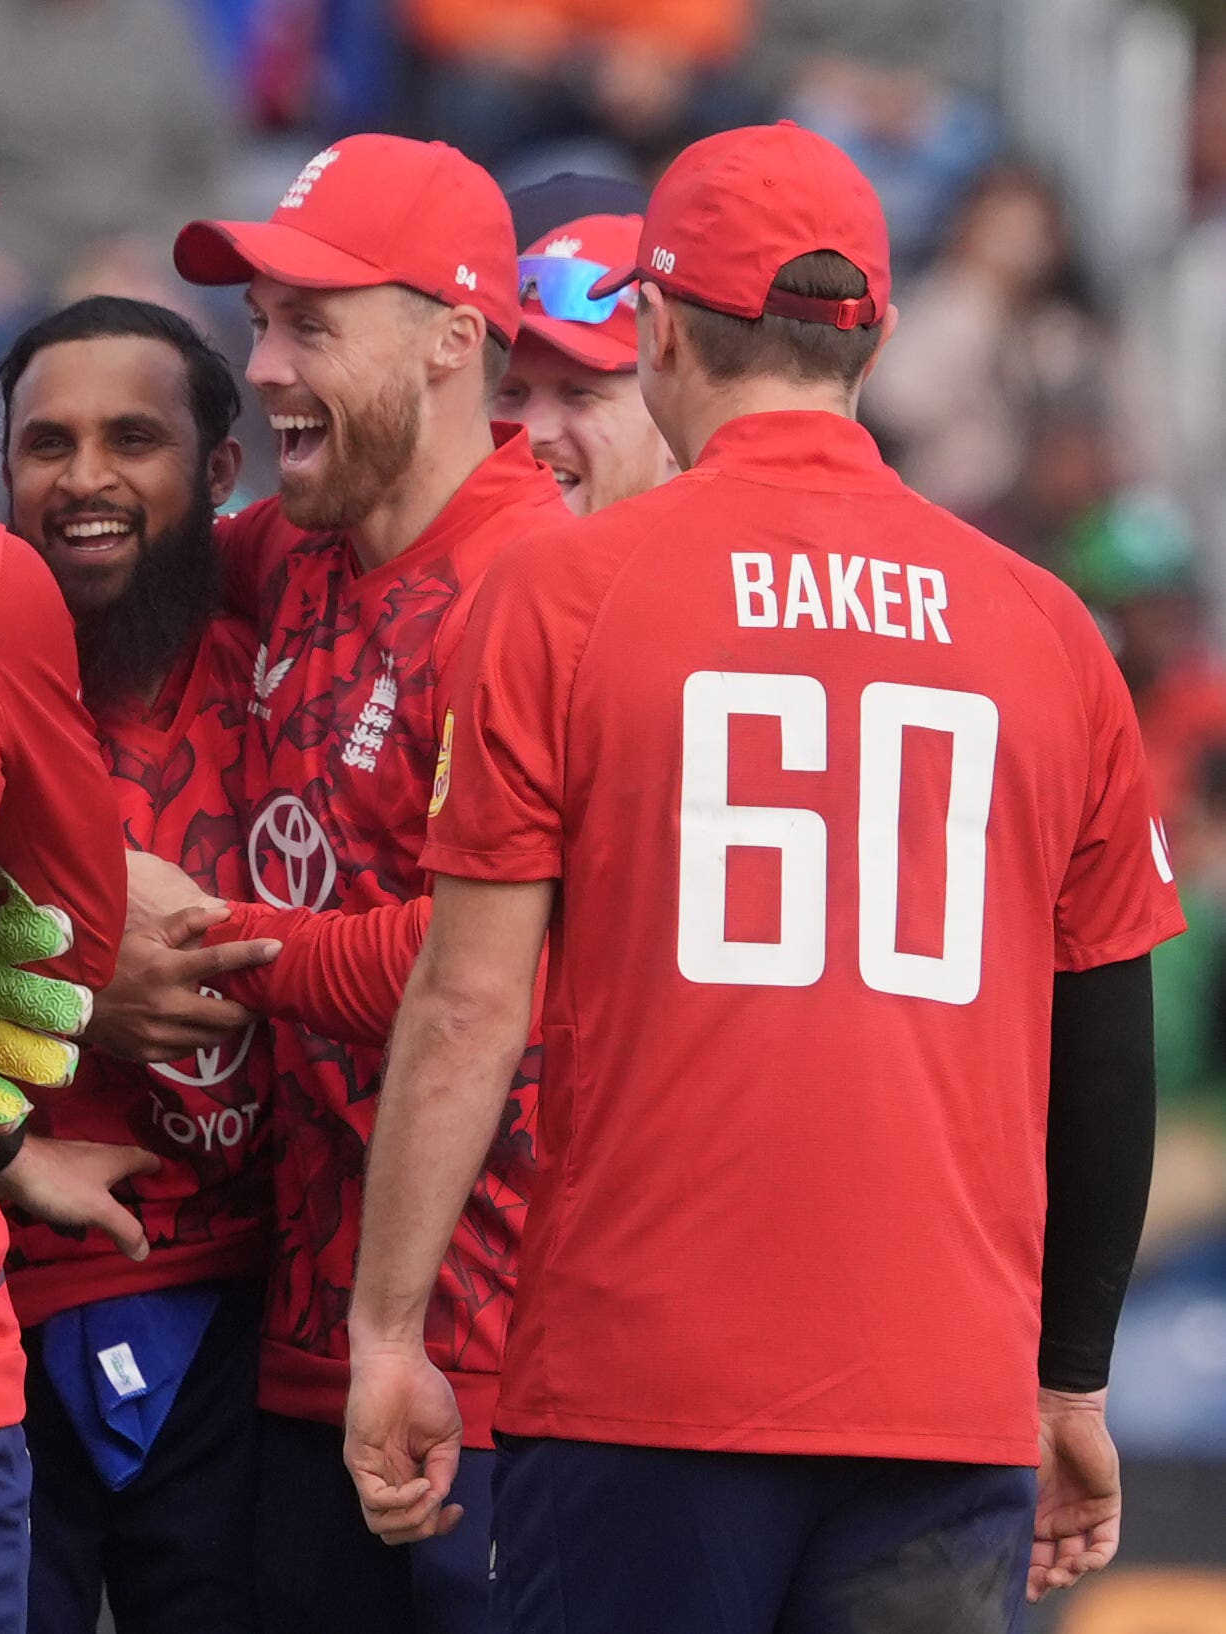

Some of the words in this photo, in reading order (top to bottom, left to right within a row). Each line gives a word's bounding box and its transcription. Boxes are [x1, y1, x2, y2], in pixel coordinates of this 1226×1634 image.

[455, 264, 477, 291] 94
[650, 245, 676, 275] 109
[730, 552, 952, 644] BAKER
[677, 670, 999, 1006] 60
